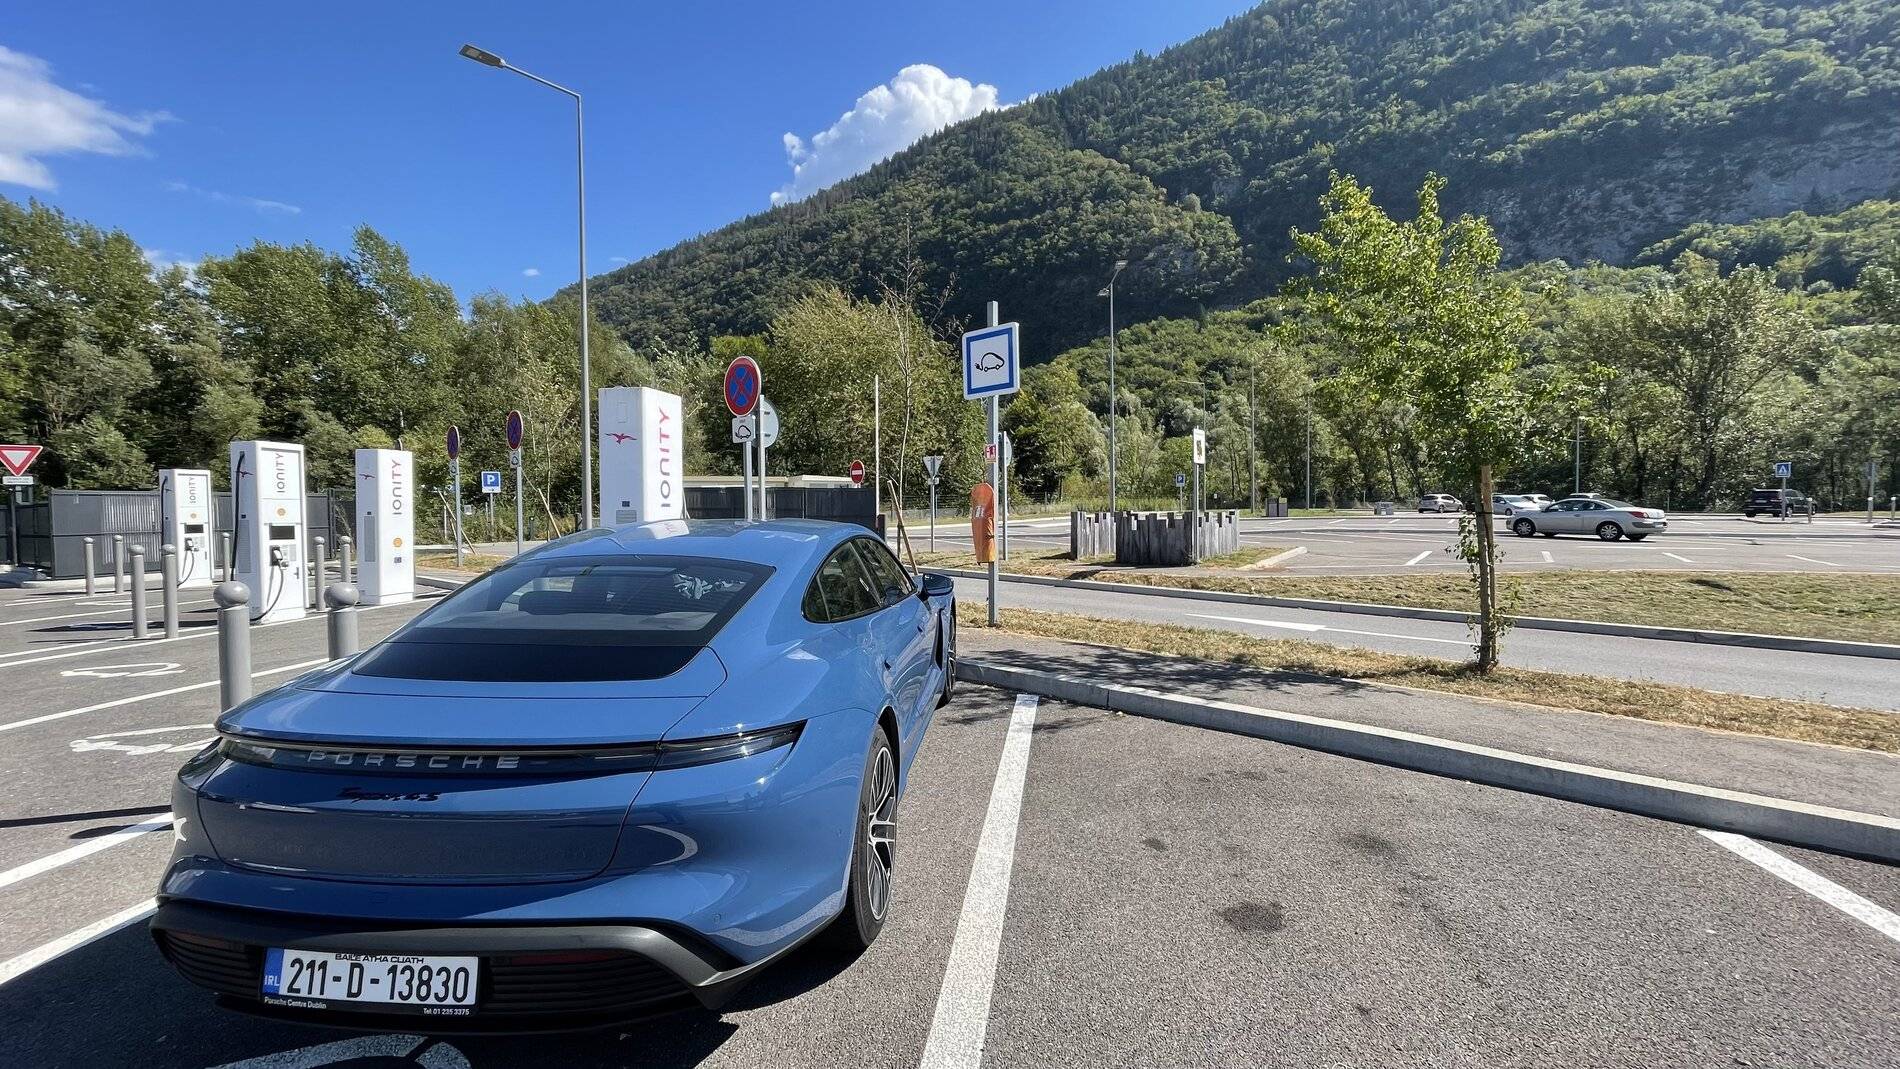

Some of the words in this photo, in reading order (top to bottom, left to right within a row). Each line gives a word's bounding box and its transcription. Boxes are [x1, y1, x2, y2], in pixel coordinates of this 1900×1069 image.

[659, 406, 671, 508] IONITY
[275, 453, 286, 493] IONITY
[391, 459, 402, 515] IONITY
[486, 474, 495, 485] P
[307, 750, 520, 769] PORSCHE
[264, 975, 280, 987] IRL
[287, 957, 469, 1003] 211-D-13830
[307, 1001, 327, 1009] Dublin
